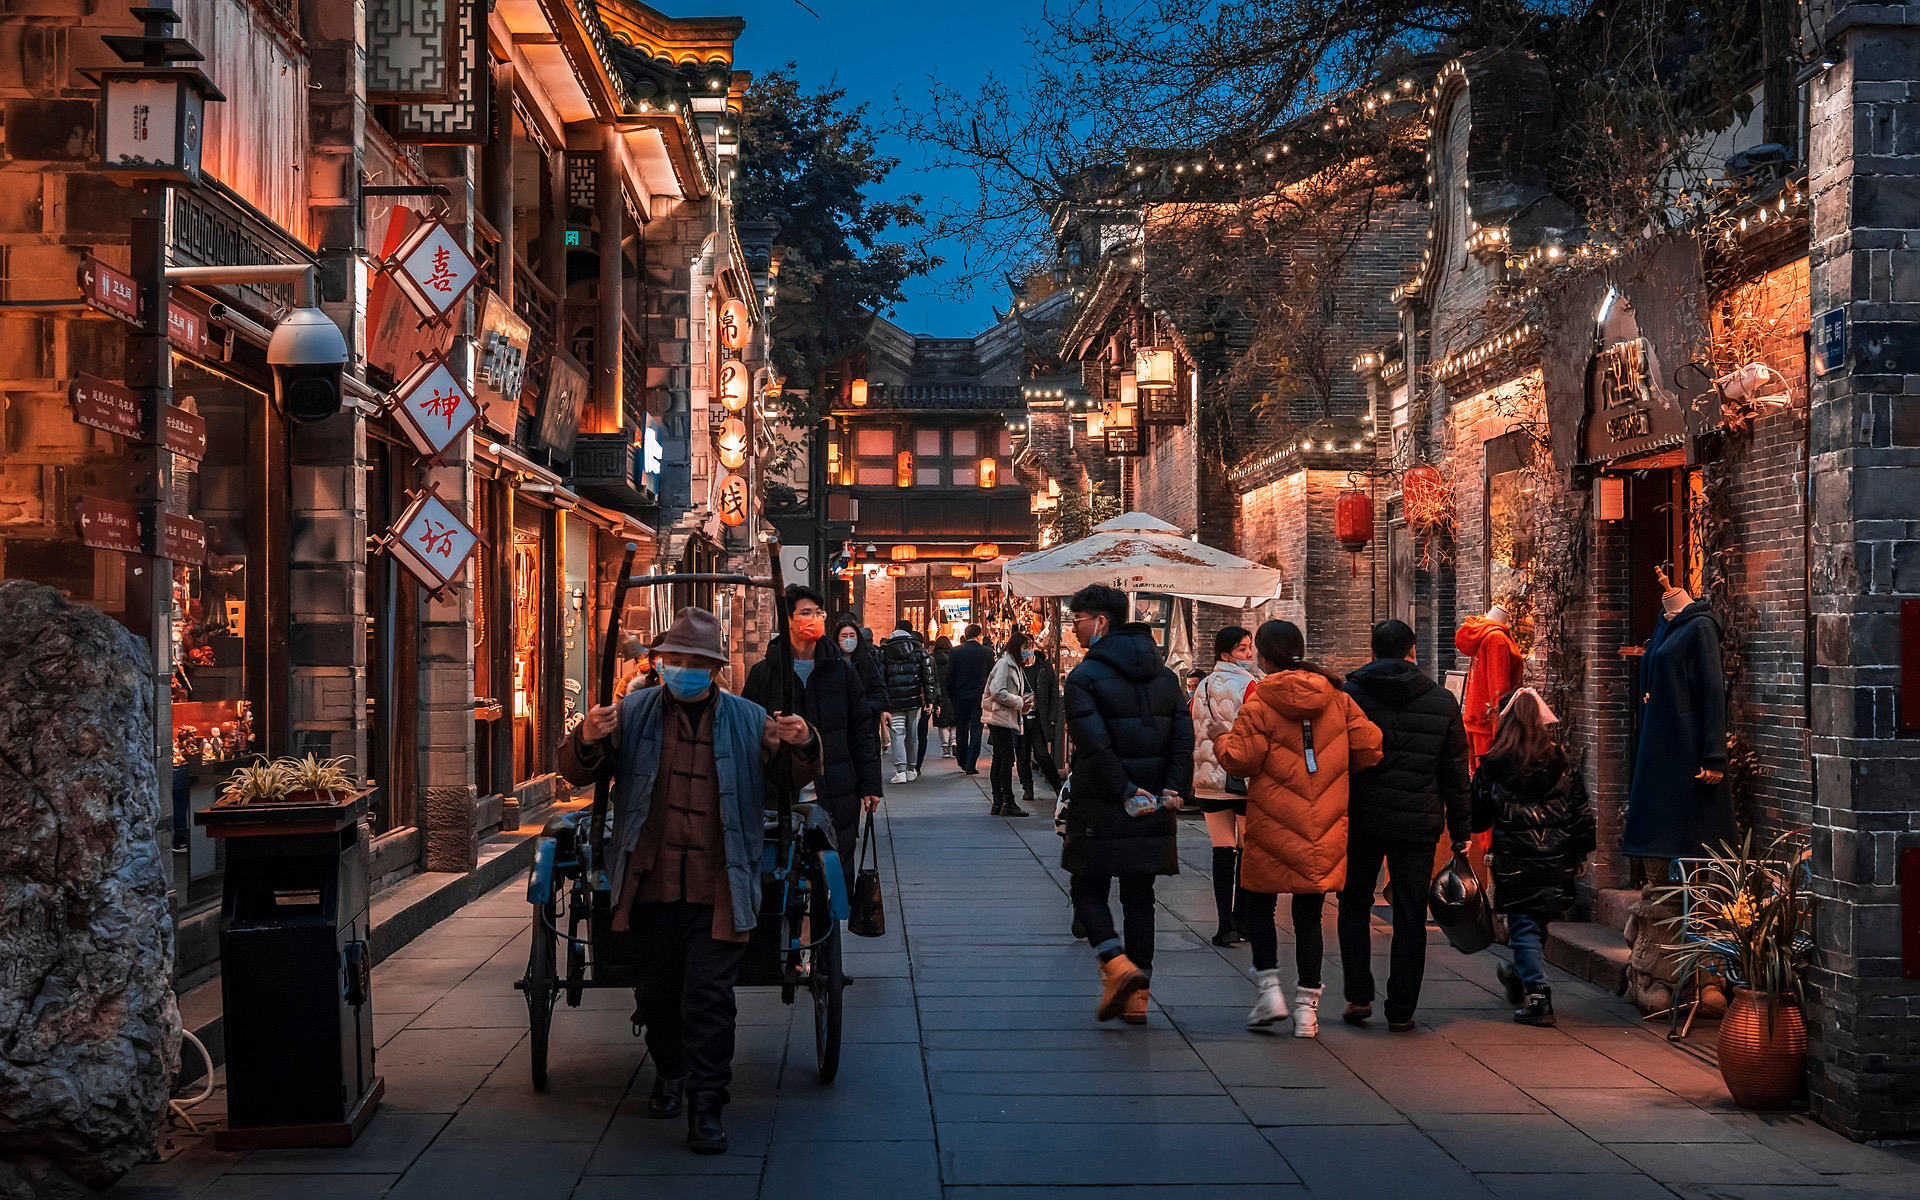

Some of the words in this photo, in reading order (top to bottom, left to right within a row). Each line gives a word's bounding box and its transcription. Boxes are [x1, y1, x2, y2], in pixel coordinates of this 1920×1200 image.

[422, 245, 458, 292] 喜
[113, 280, 132, 300] 卫生间
[168, 310, 185, 330] 卫生间
[419, 387, 461, 430] 神
[418, 518, 459, 558] 坊
